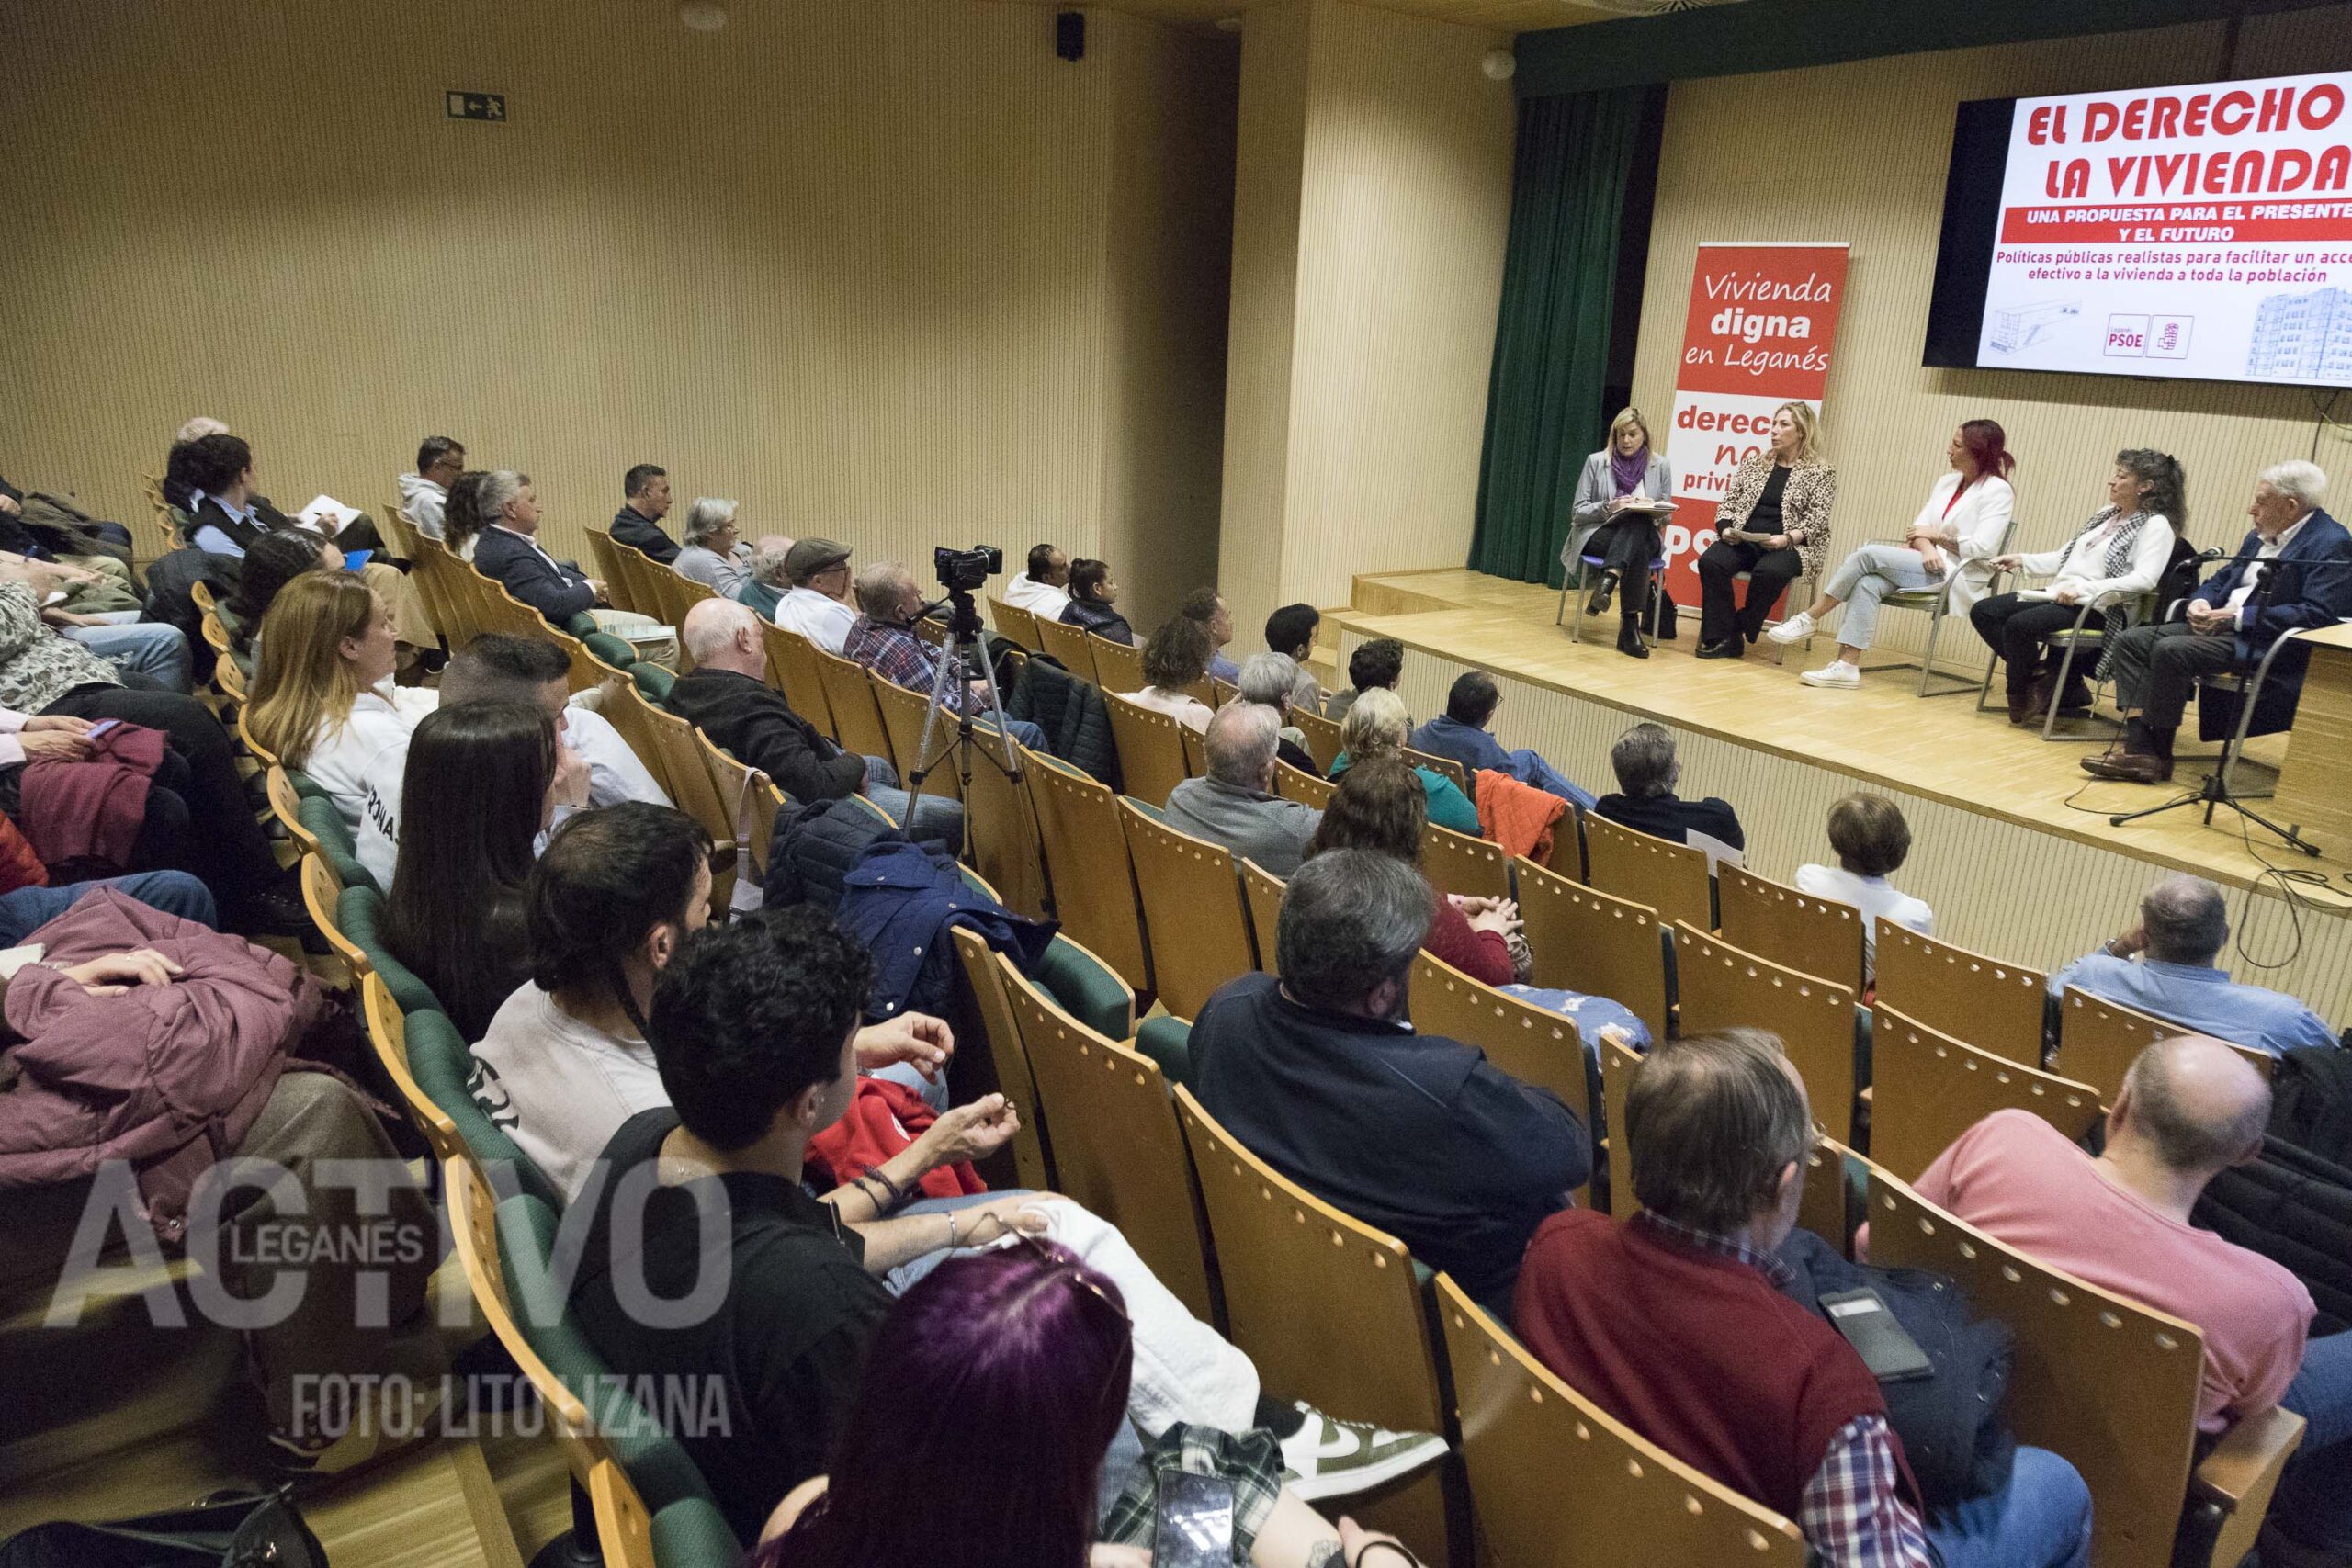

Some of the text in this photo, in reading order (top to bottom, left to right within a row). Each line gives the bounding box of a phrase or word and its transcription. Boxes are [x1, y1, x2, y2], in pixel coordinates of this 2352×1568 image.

[2028, 83, 2346, 146] EL DERECHO
[2045, 144, 2352, 199] LA VIVIENDA
[2027, 210, 2060, 224] UNA
[2064, 208, 2165, 223] PROPUESTA
[2169, 207, 2218, 220] PARA
[2222, 206, 2246, 220] EL
[2119, 226, 2235, 242] Y EL FUTURO
[1996, 250, 2052, 264] Políticas
[2055, 249, 2113, 266] públicas
[2117, 250, 2182, 264] realistas
[2186, 253, 2222, 267] para
[2225, 249, 2290, 264] facilitar
[2294, 253, 2315, 264] un
[1705, 271, 1833, 303] Vivienda
[2028, 266, 2327, 285] efectivo a la vivienda a toda la población
[1710, 307, 1811, 344] digna
[2109, 333, 2143, 348] PSOE
[1685, 344, 1829, 376] en Leganés
[1677, 404, 1771, 436] derec
[1683, 471, 1732, 492] privi
[1664, 524, 1719, 575] PS
